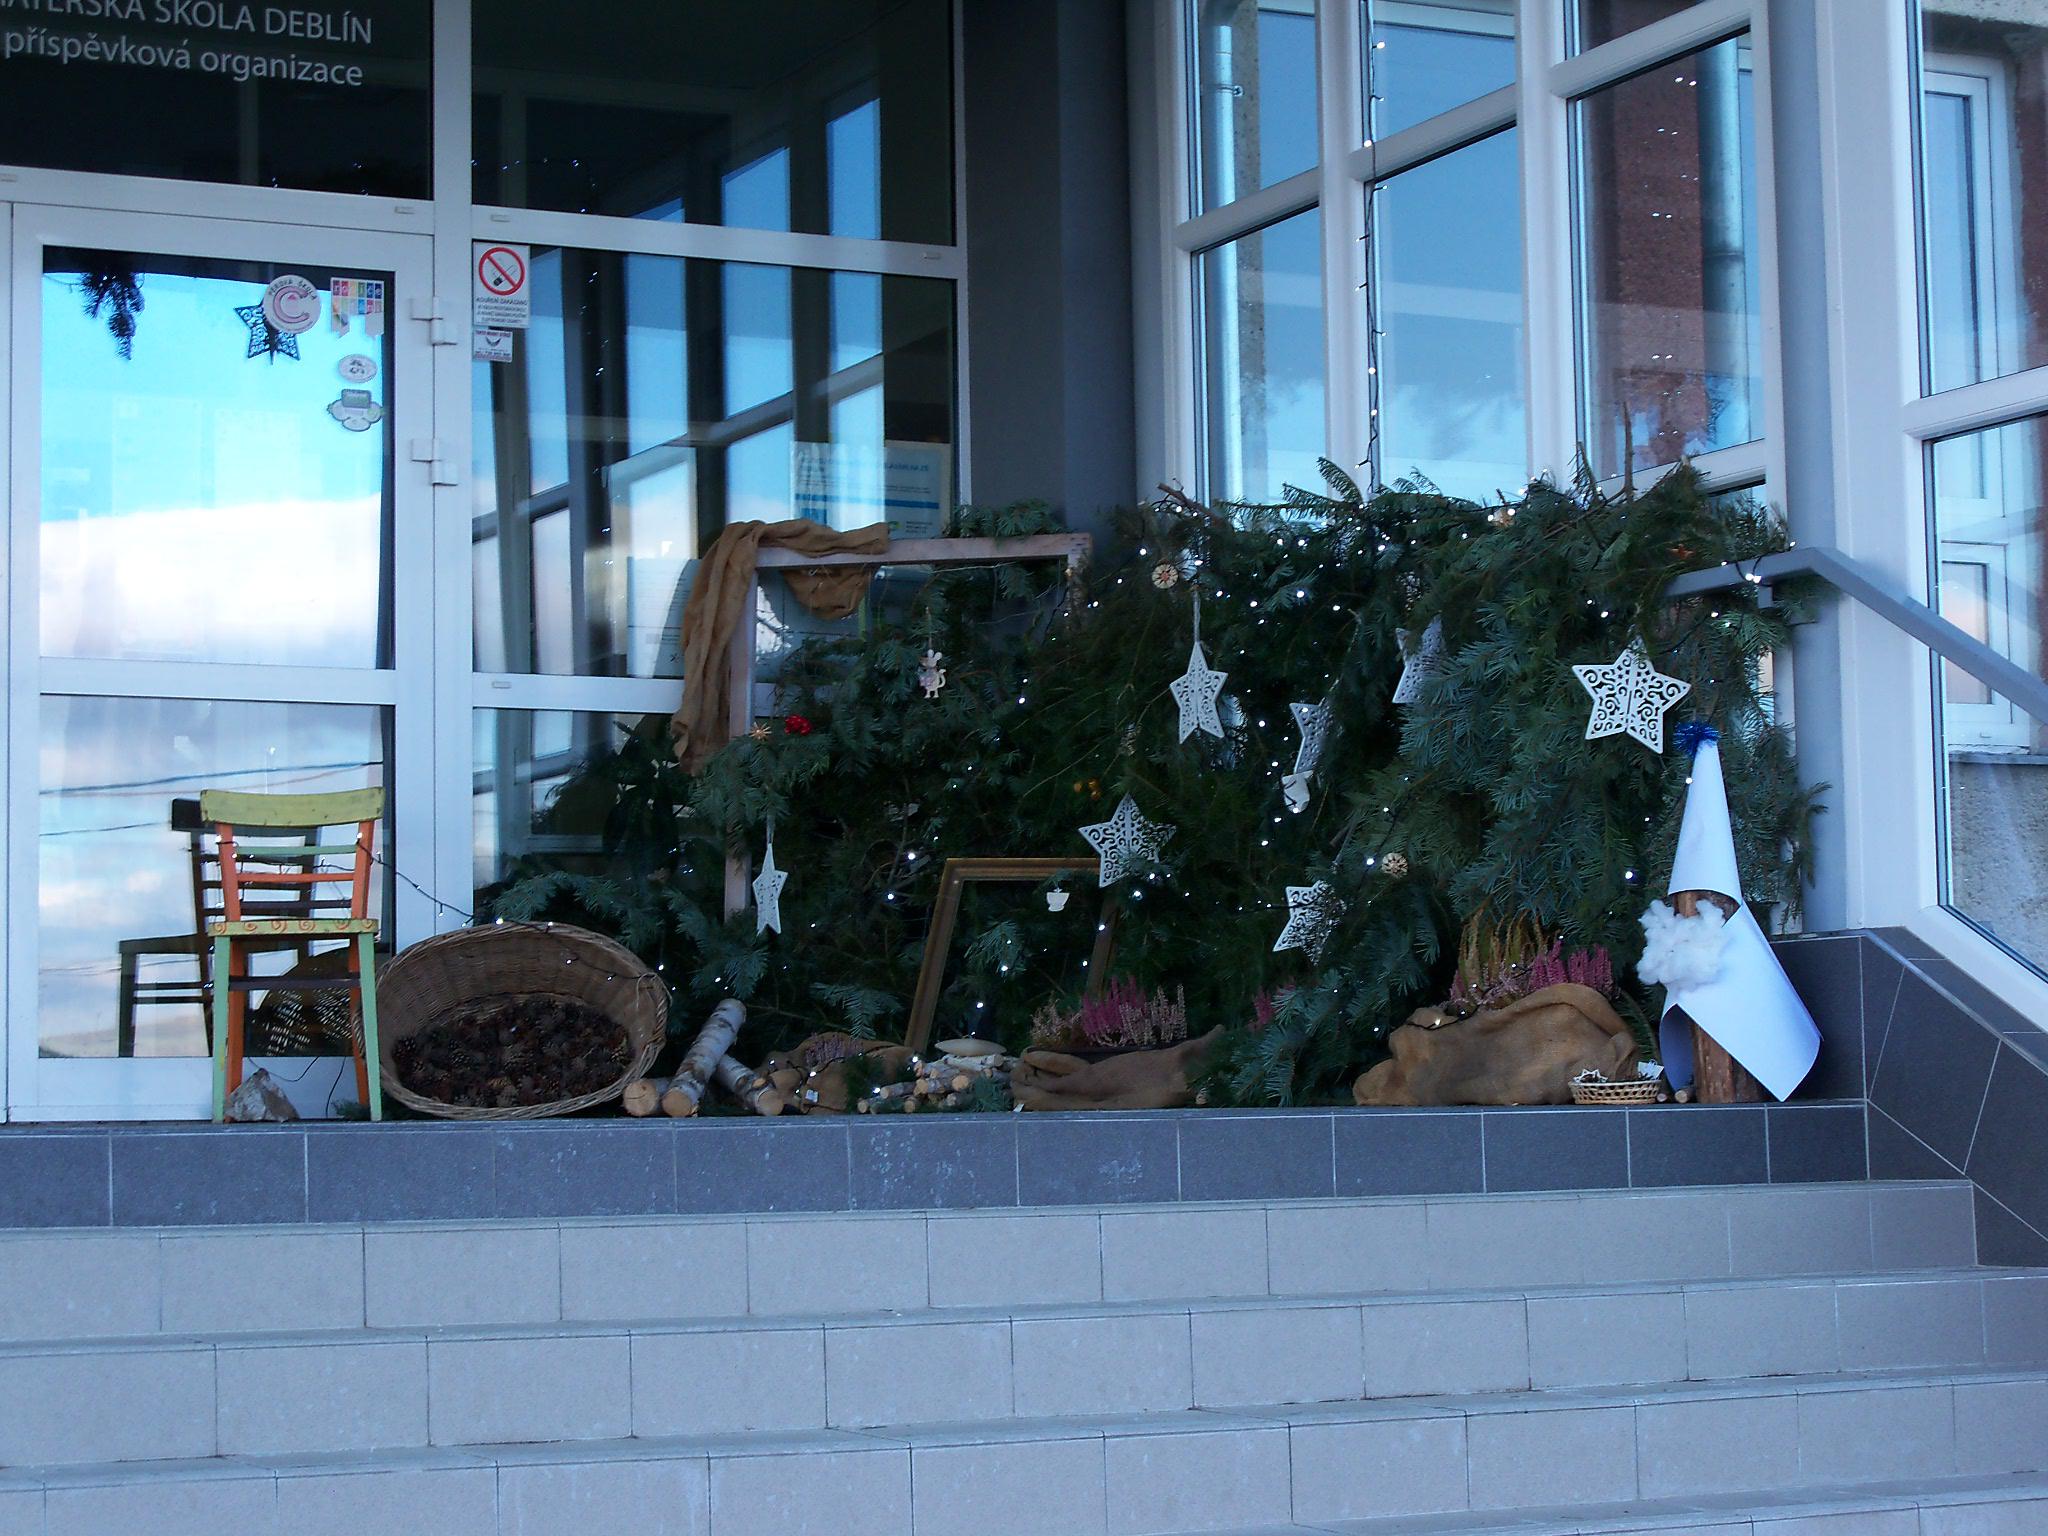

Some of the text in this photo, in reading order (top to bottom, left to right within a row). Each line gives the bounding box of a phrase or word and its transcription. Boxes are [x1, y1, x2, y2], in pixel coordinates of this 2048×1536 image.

[265, 8, 373, 44] DEBLÍN
[4, 26, 364, 86] příspěvková organizace
